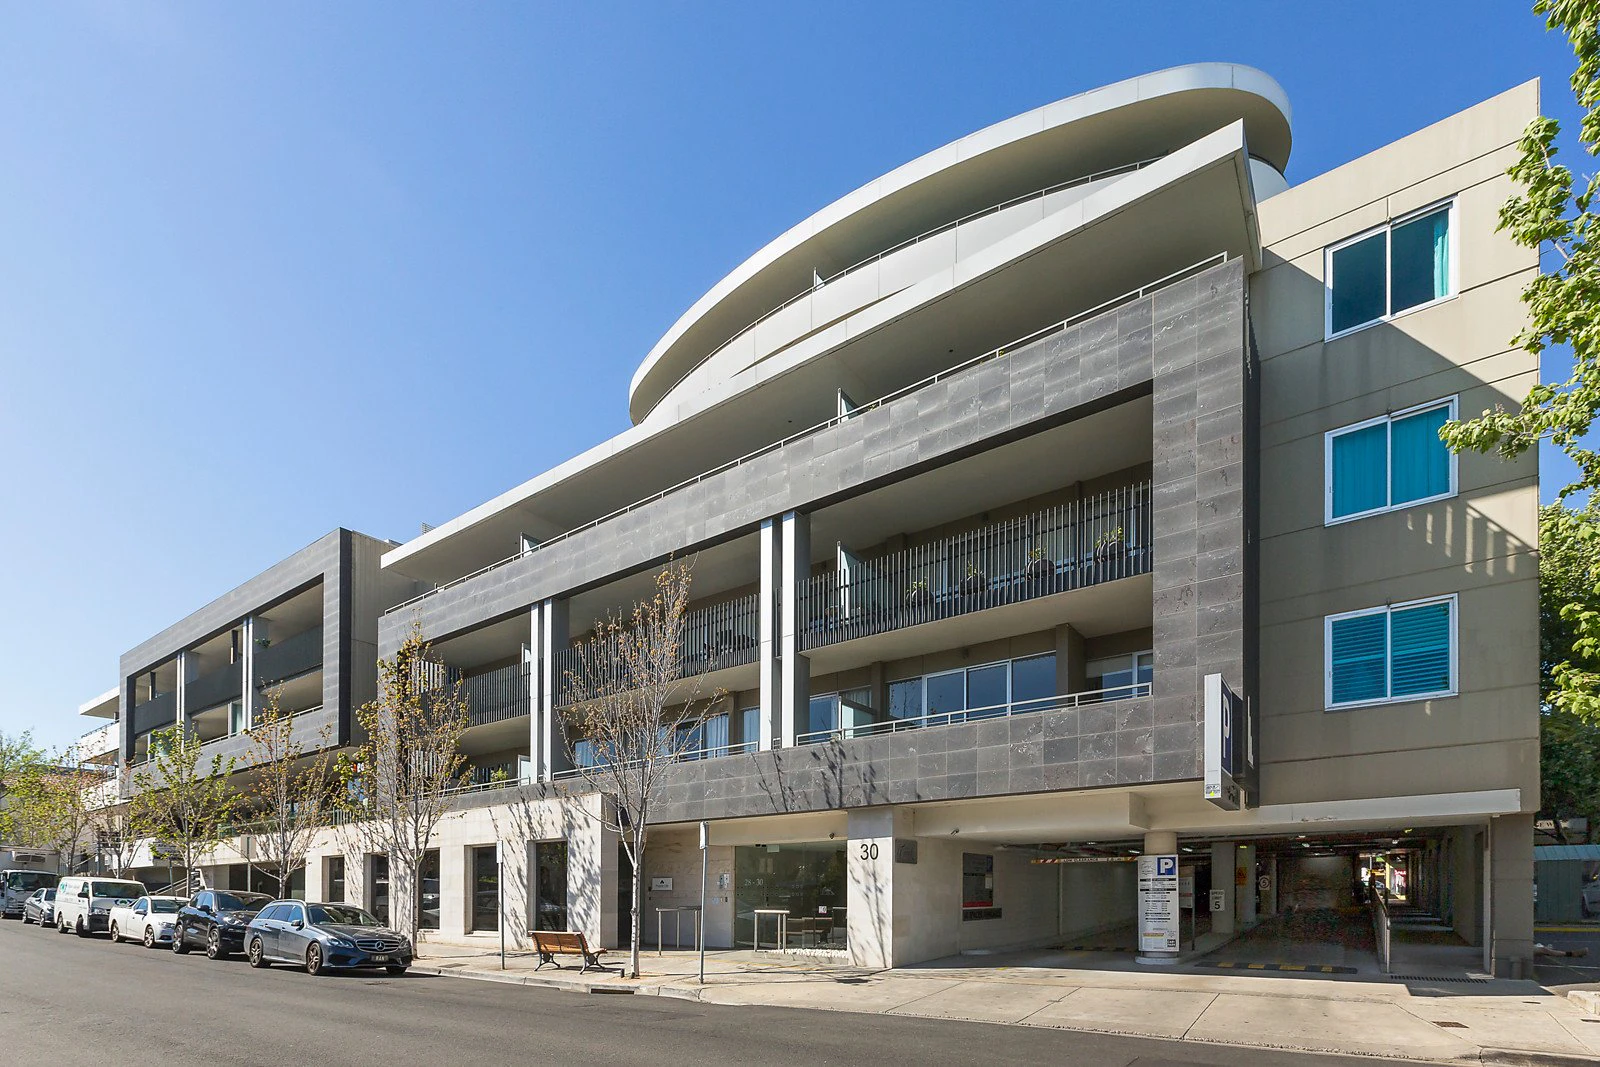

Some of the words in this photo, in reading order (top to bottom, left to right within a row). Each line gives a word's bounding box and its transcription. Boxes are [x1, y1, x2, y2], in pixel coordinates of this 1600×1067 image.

[1223, 694, 1230, 758] P
[860, 843, 879, 860] 30
[1160, 858, 1174, 874] P
[756, 878, 764, 886] 30
[1214, 901, 1220, 910] 5
